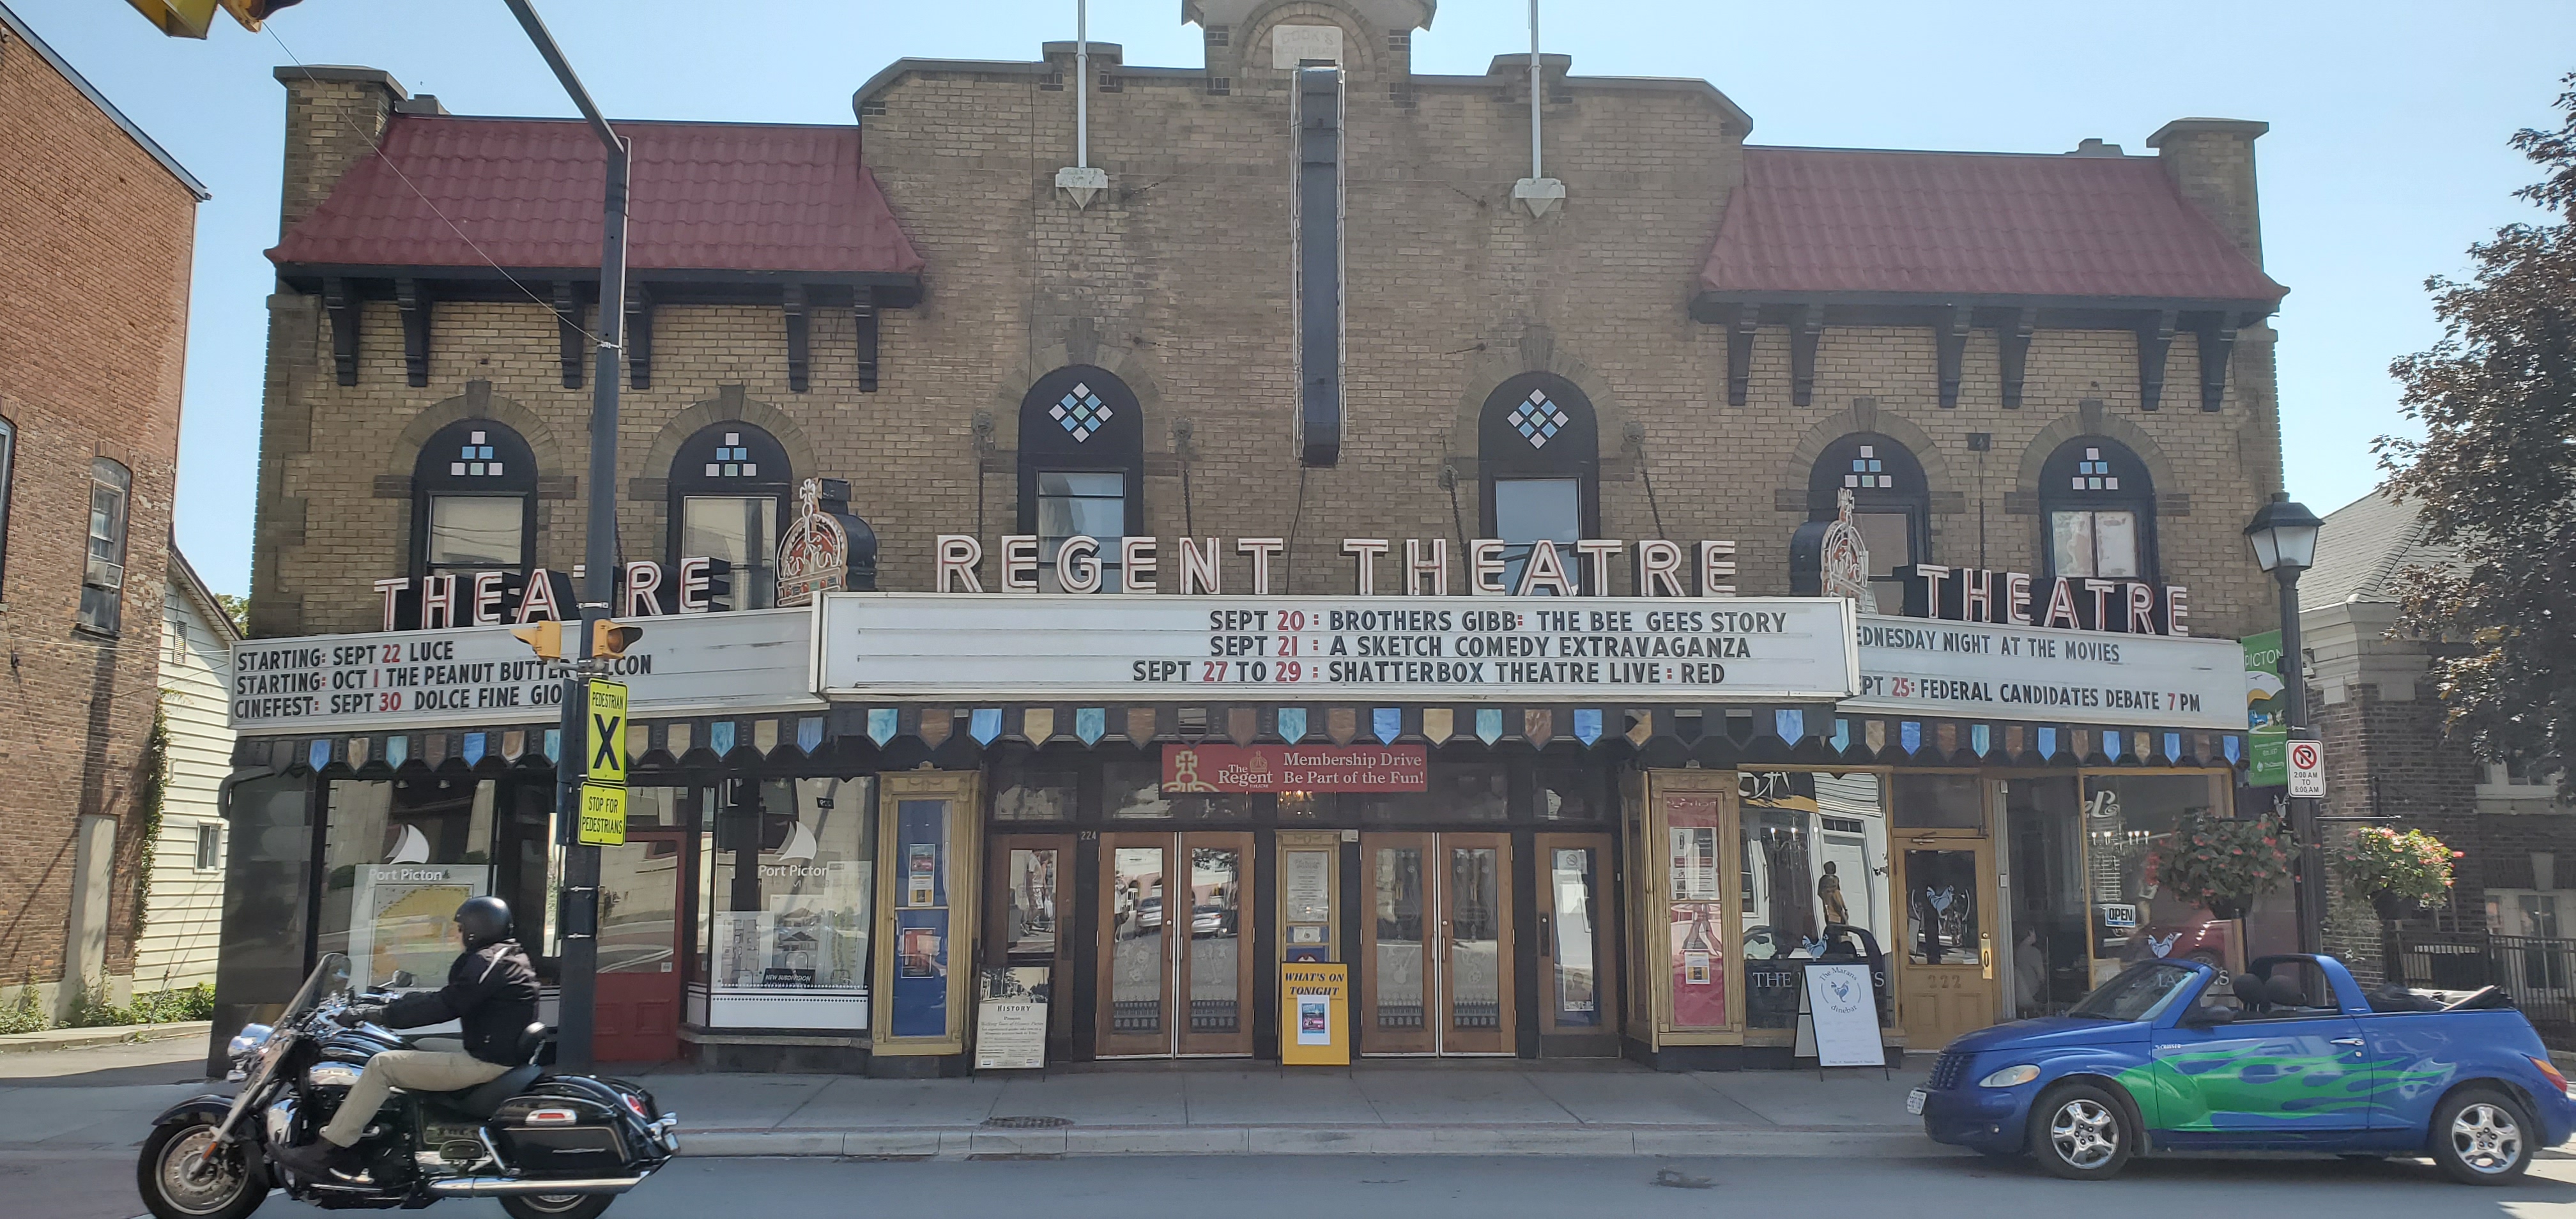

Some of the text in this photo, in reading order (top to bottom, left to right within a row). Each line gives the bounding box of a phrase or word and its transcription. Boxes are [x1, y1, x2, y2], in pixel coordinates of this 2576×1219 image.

[937, 535, 1736, 597] REGENT THEATRE
[374, 556, 711, 631] THEARE
[1917, 564, 2189, 637] THEATRE
[1210, 610, 1268, 631] SEPT
[1277, 610, 1305, 631] 20
[1330, 611, 1452, 632] BROTHERS
[1537, 611, 1583, 632] THE
[1591, 611, 1632, 632] BEE
[1646, 611, 1701, 632] GEES
[1712, 612, 1788, 633] STORY
[1210, 636, 1268, 656] SEPT
[1277, 636, 1298, 656] 21
[1329, 636, 1347, 656] A
[1358, 636, 1441, 657] SKETCH
[1455, 637, 1547, 657] COMEDY
[1560, 637, 1751, 658] EXTRAVAGANZA
[1857, 625, 2120, 662] EDNESDAY NIGHT AT THE MOVIES
[238, 641, 454, 671] STARTING: SEPT 22 LUCE
[2245, 648, 2283, 668] PICTON
[237, 671, 326, 694] STARTING:
[332, 670, 367, 689] OCT
[387, 666, 419, 687] THE
[424, 662, 494, 686] PEANUT
[1133, 660, 1192, 681] SEPT
[1203, 661, 1227, 681] 27
[1236, 661, 1266, 681] TO
[1275, 661, 1301, 681] 29
[1330, 661, 1484, 683] SHATTERBOX
[1496, 663, 1598, 683] THEATRE
[1609, 663, 1660, 683] LIVE
[1682, 663, 1725, 684] RED
[234, 696, 319, 719] CINEFEST:
[331, 693, 374, 714] SEPT
[379, 692, 402, 712] 30
[415, 689, 470, 710] DOLCE
[479, 686, 519, 707] FINE
[592, 691, 624, 710] PEDESTRIAN
[1920, 678, 1993, 702] FEDERAL
[2000, 684, 2099, 707] CANDIDATES
[2106, 689, 2159, 710] DEBATE
[2167, 693, 2175, 710] 7
[2180, 693, 2200, 712] PM
[593, 713, 621, 770] X
[1228, 764, 1248, 774] The
[1284, 752, 1422, 769] Membership Drive
[1218, 769, 1273, 786] Regent
[1283, 771, 1424, 785] Be Part of the Fun!
[588, 795, 618, 813] STOP FOR
[582, 816, 623, 834] PEDESTRIANS
[1080, 831, 1096, 840] 224
[369, 868, 442, 881] Port Picton
[759, 865, 786, 877] Port
[2108, 907, 2133, 922] OPEN
[1285, 972, 1344, 983] WHAT'S ON
[1753, 972, 1793, 988] THE
[1819, 970, 1831, 981] The
[1832, 967, 1857, 981] Marans
[1928, 974, 1961, 988] 222
[1290, 986, 1339, 996] TONIGHT
[1830, 1004, 1858, 1014] dinebar
